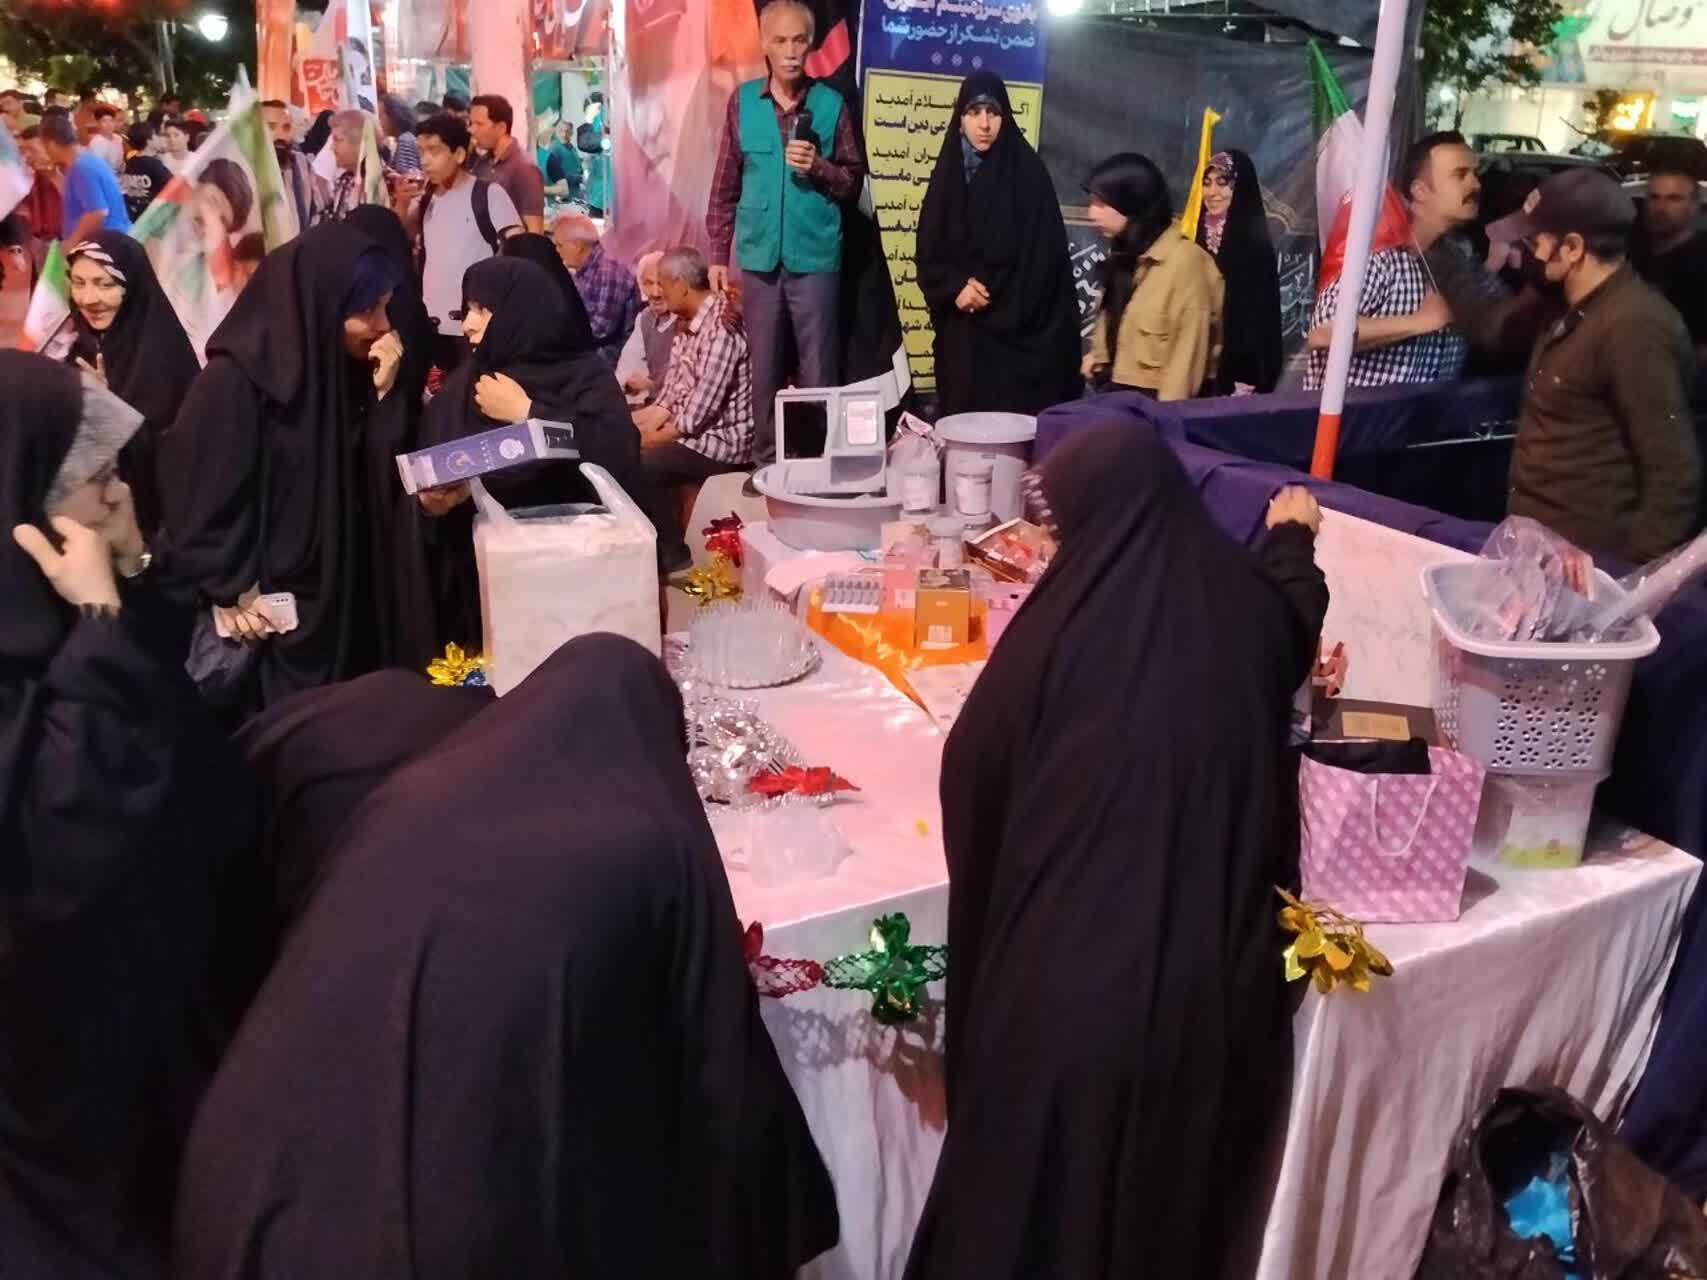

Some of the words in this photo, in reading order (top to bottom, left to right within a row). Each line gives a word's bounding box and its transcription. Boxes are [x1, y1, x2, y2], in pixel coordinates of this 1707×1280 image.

[881, 16, 909, 35] شما
[907, 19, 947, 41] حضور
[945, 22, 958, 45] از
[957, 25, 999, 45] تشکر
[999, 31, 1035, 50] ضمن
[875, 89, 913, 109] آمدید
[914, 95, 957, 112] سلام
[874, 115, 906, 129] است
[872, 142, 910, 162] آمدید
[875, 193, 907, 213] آمدی
